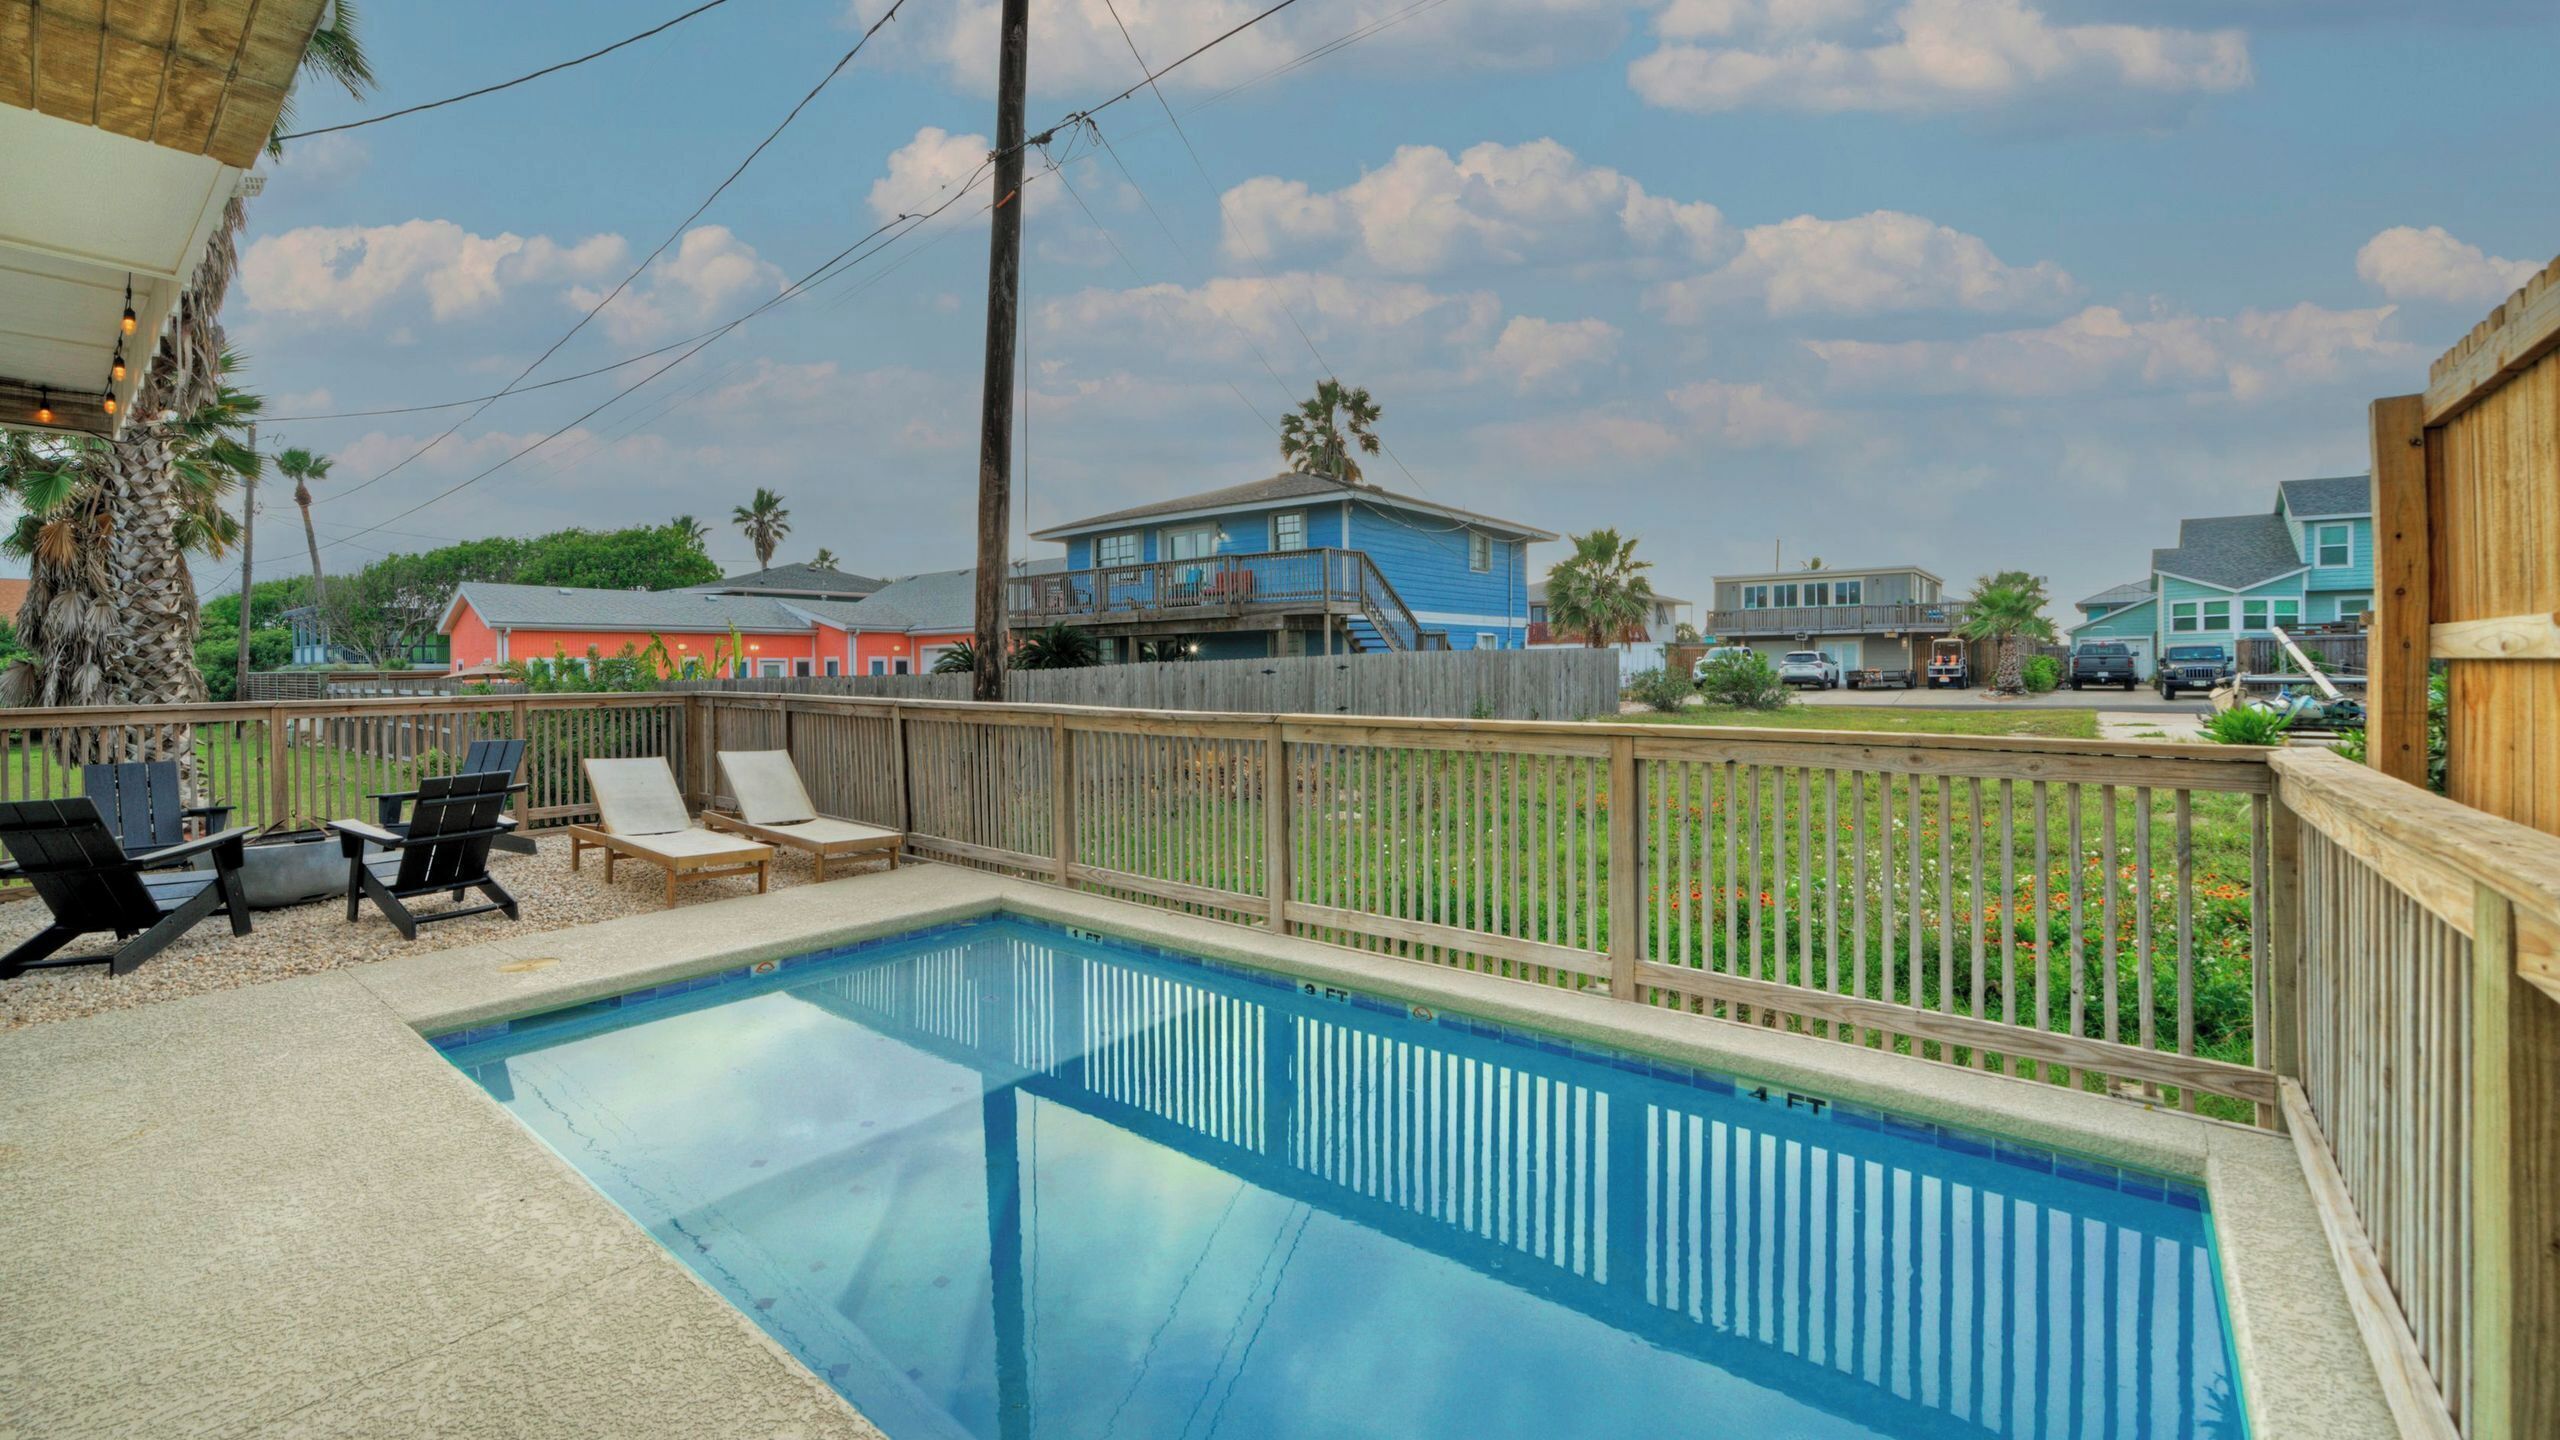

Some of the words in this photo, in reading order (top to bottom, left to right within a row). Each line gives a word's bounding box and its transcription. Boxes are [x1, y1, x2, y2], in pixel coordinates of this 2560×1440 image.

[1086, 932, 1101, 943] FT
[1326, 987, 1348, 1002] FT
[1748, 1086, 1769, 1102] 4
[1787, 1092, 1826, 1114] FT
